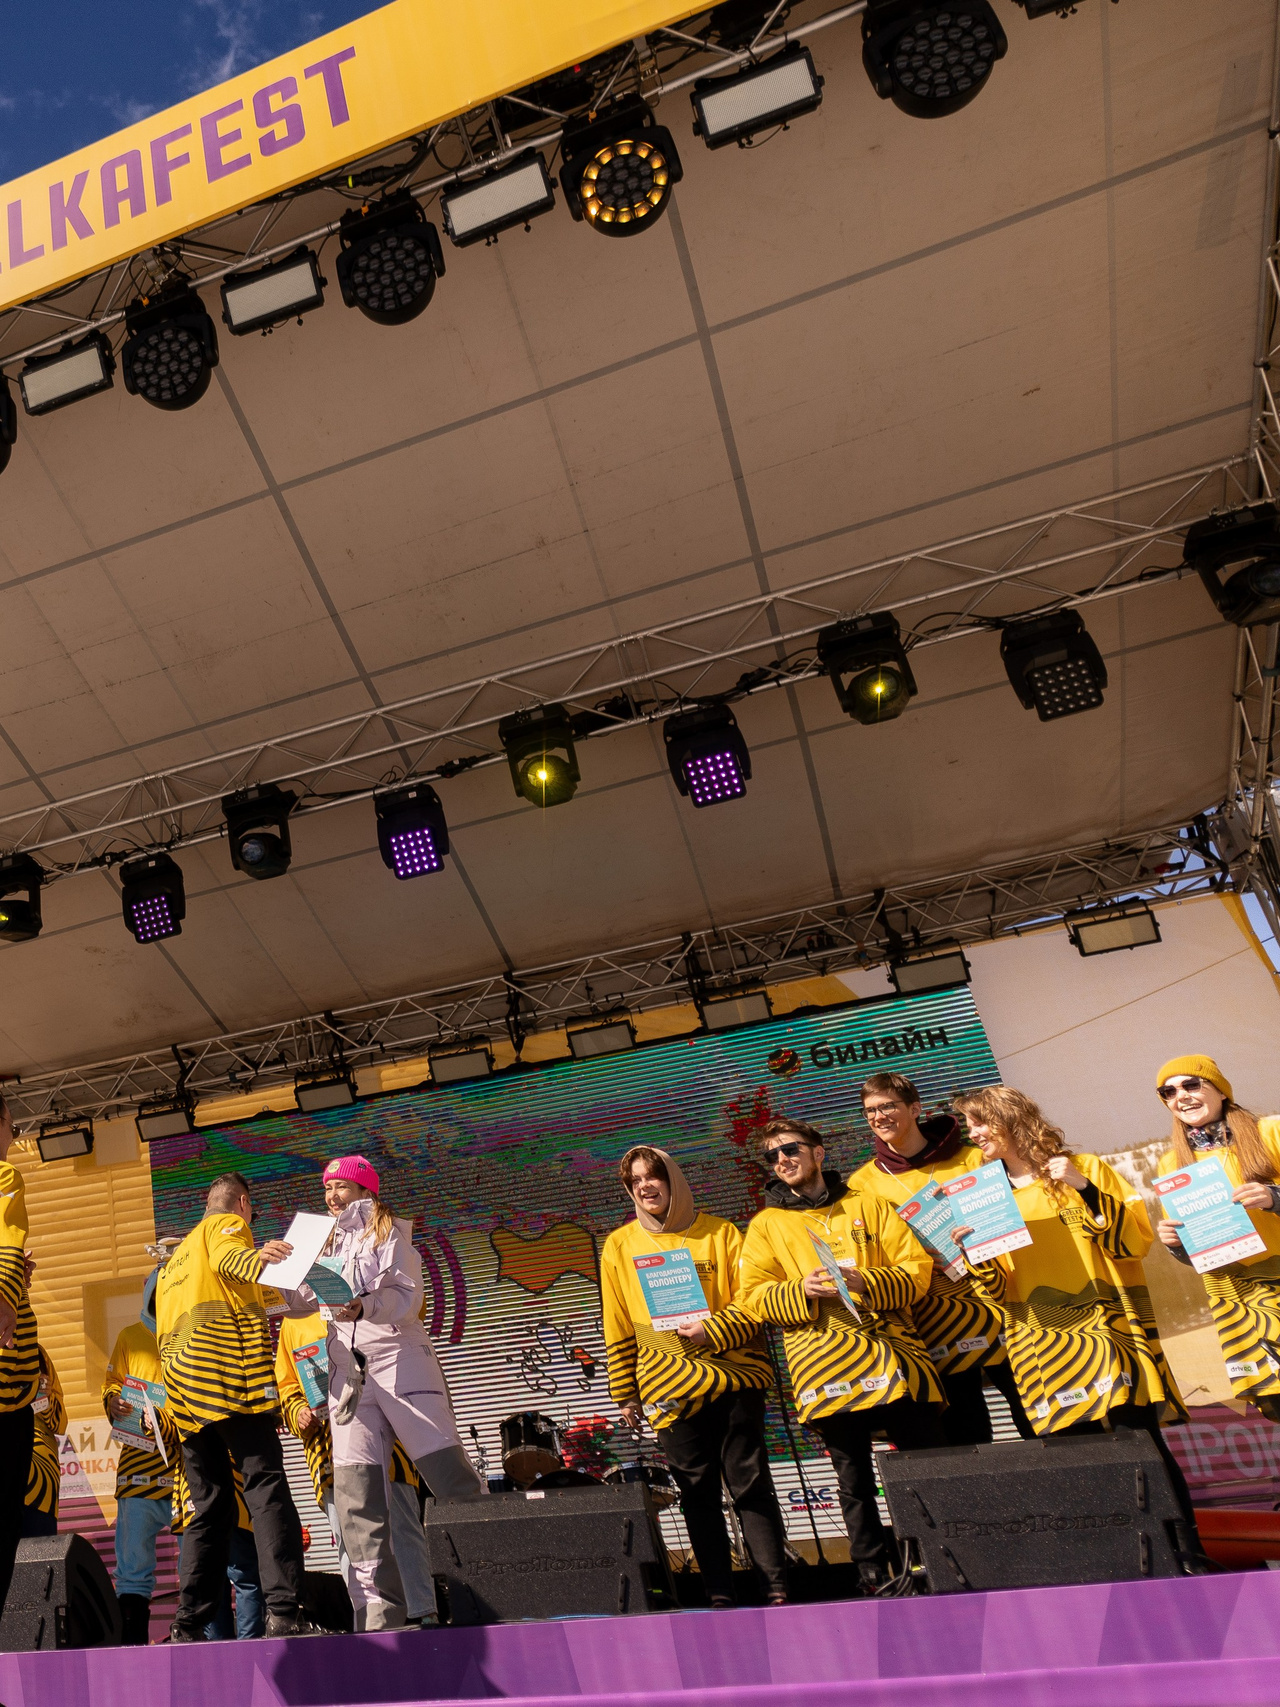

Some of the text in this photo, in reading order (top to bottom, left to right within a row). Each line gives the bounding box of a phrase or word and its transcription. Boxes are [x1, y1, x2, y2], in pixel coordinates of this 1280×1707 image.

[809, 1025, 951, 1069] билайн
[982, 1166, 1001, 1180] 2024
[1197, 1162, 1219, 1178] 2024
[957, 1182, 1004, 1205] БЛАГОДАРНОСТЬ
[960, 1190, 1006, 1215] ВОЛОНТЕРУ
[1171, 1181, 1225, 1207] БЛАГОДАРНОСТЬ
[1176, 1190, 1229, 1218] ВОЛОНТЕРУ
[670, 1252, 690, 1262] 2024
[645, 1266, 691, 1279] БЛАГОДАРНОСТЬ
[647, 1273, 692, 1288] ВОЛОНТЕРУ
[151, 1386, 166, 1397] 2024
[943, 1513, 1133, 1539] ProTone
[468, 1554, 618, 1577] ProTone
